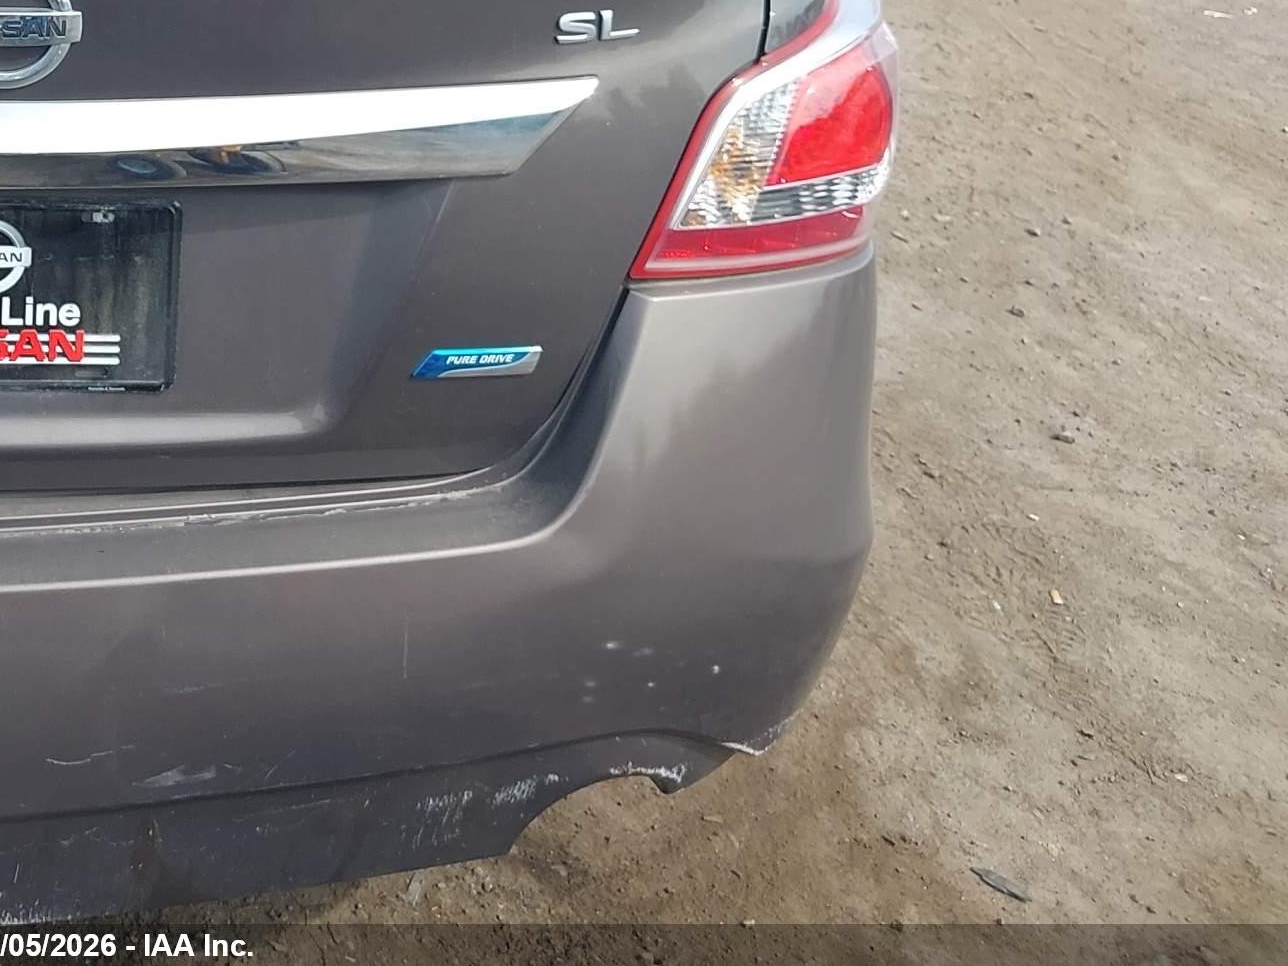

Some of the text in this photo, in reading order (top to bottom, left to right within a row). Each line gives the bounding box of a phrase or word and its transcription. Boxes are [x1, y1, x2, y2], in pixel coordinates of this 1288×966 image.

[555, 9, 640, 45] SL
[1, 296, 81, 327] Line
[446, 353, 515, 365] PURE DRIVE
